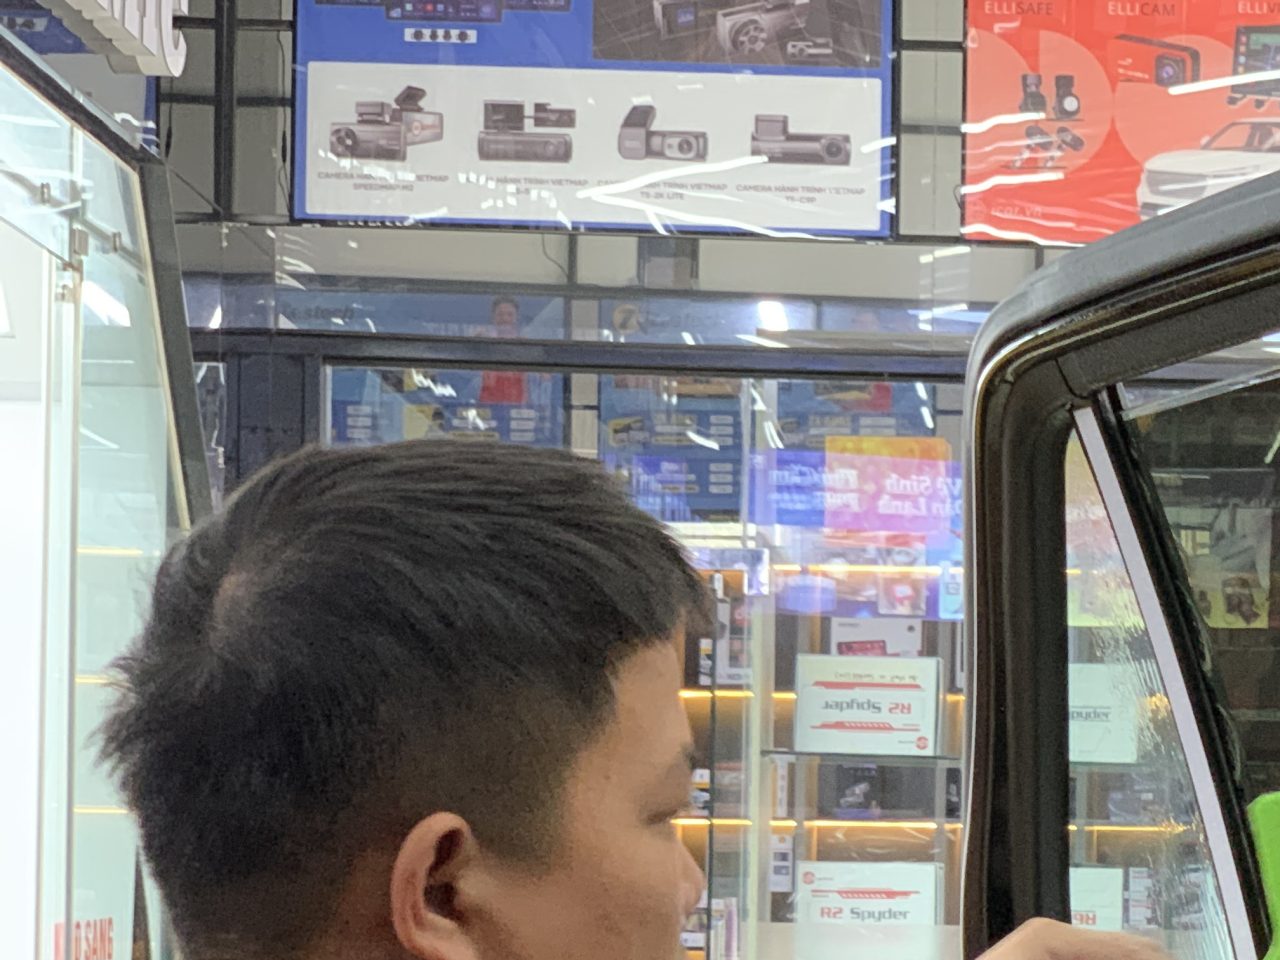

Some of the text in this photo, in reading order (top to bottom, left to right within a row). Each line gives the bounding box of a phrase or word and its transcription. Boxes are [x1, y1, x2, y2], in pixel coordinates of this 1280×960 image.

[983, 1, 1054, 16] ELLISAFE
[1107, 1, 1176, 17] ELLICAM
[416, 174, 450, 182] IETMAP
[821, 698, 912, 716] R2 Spyder
[820, 906, 910, 922] R2 Spyder
